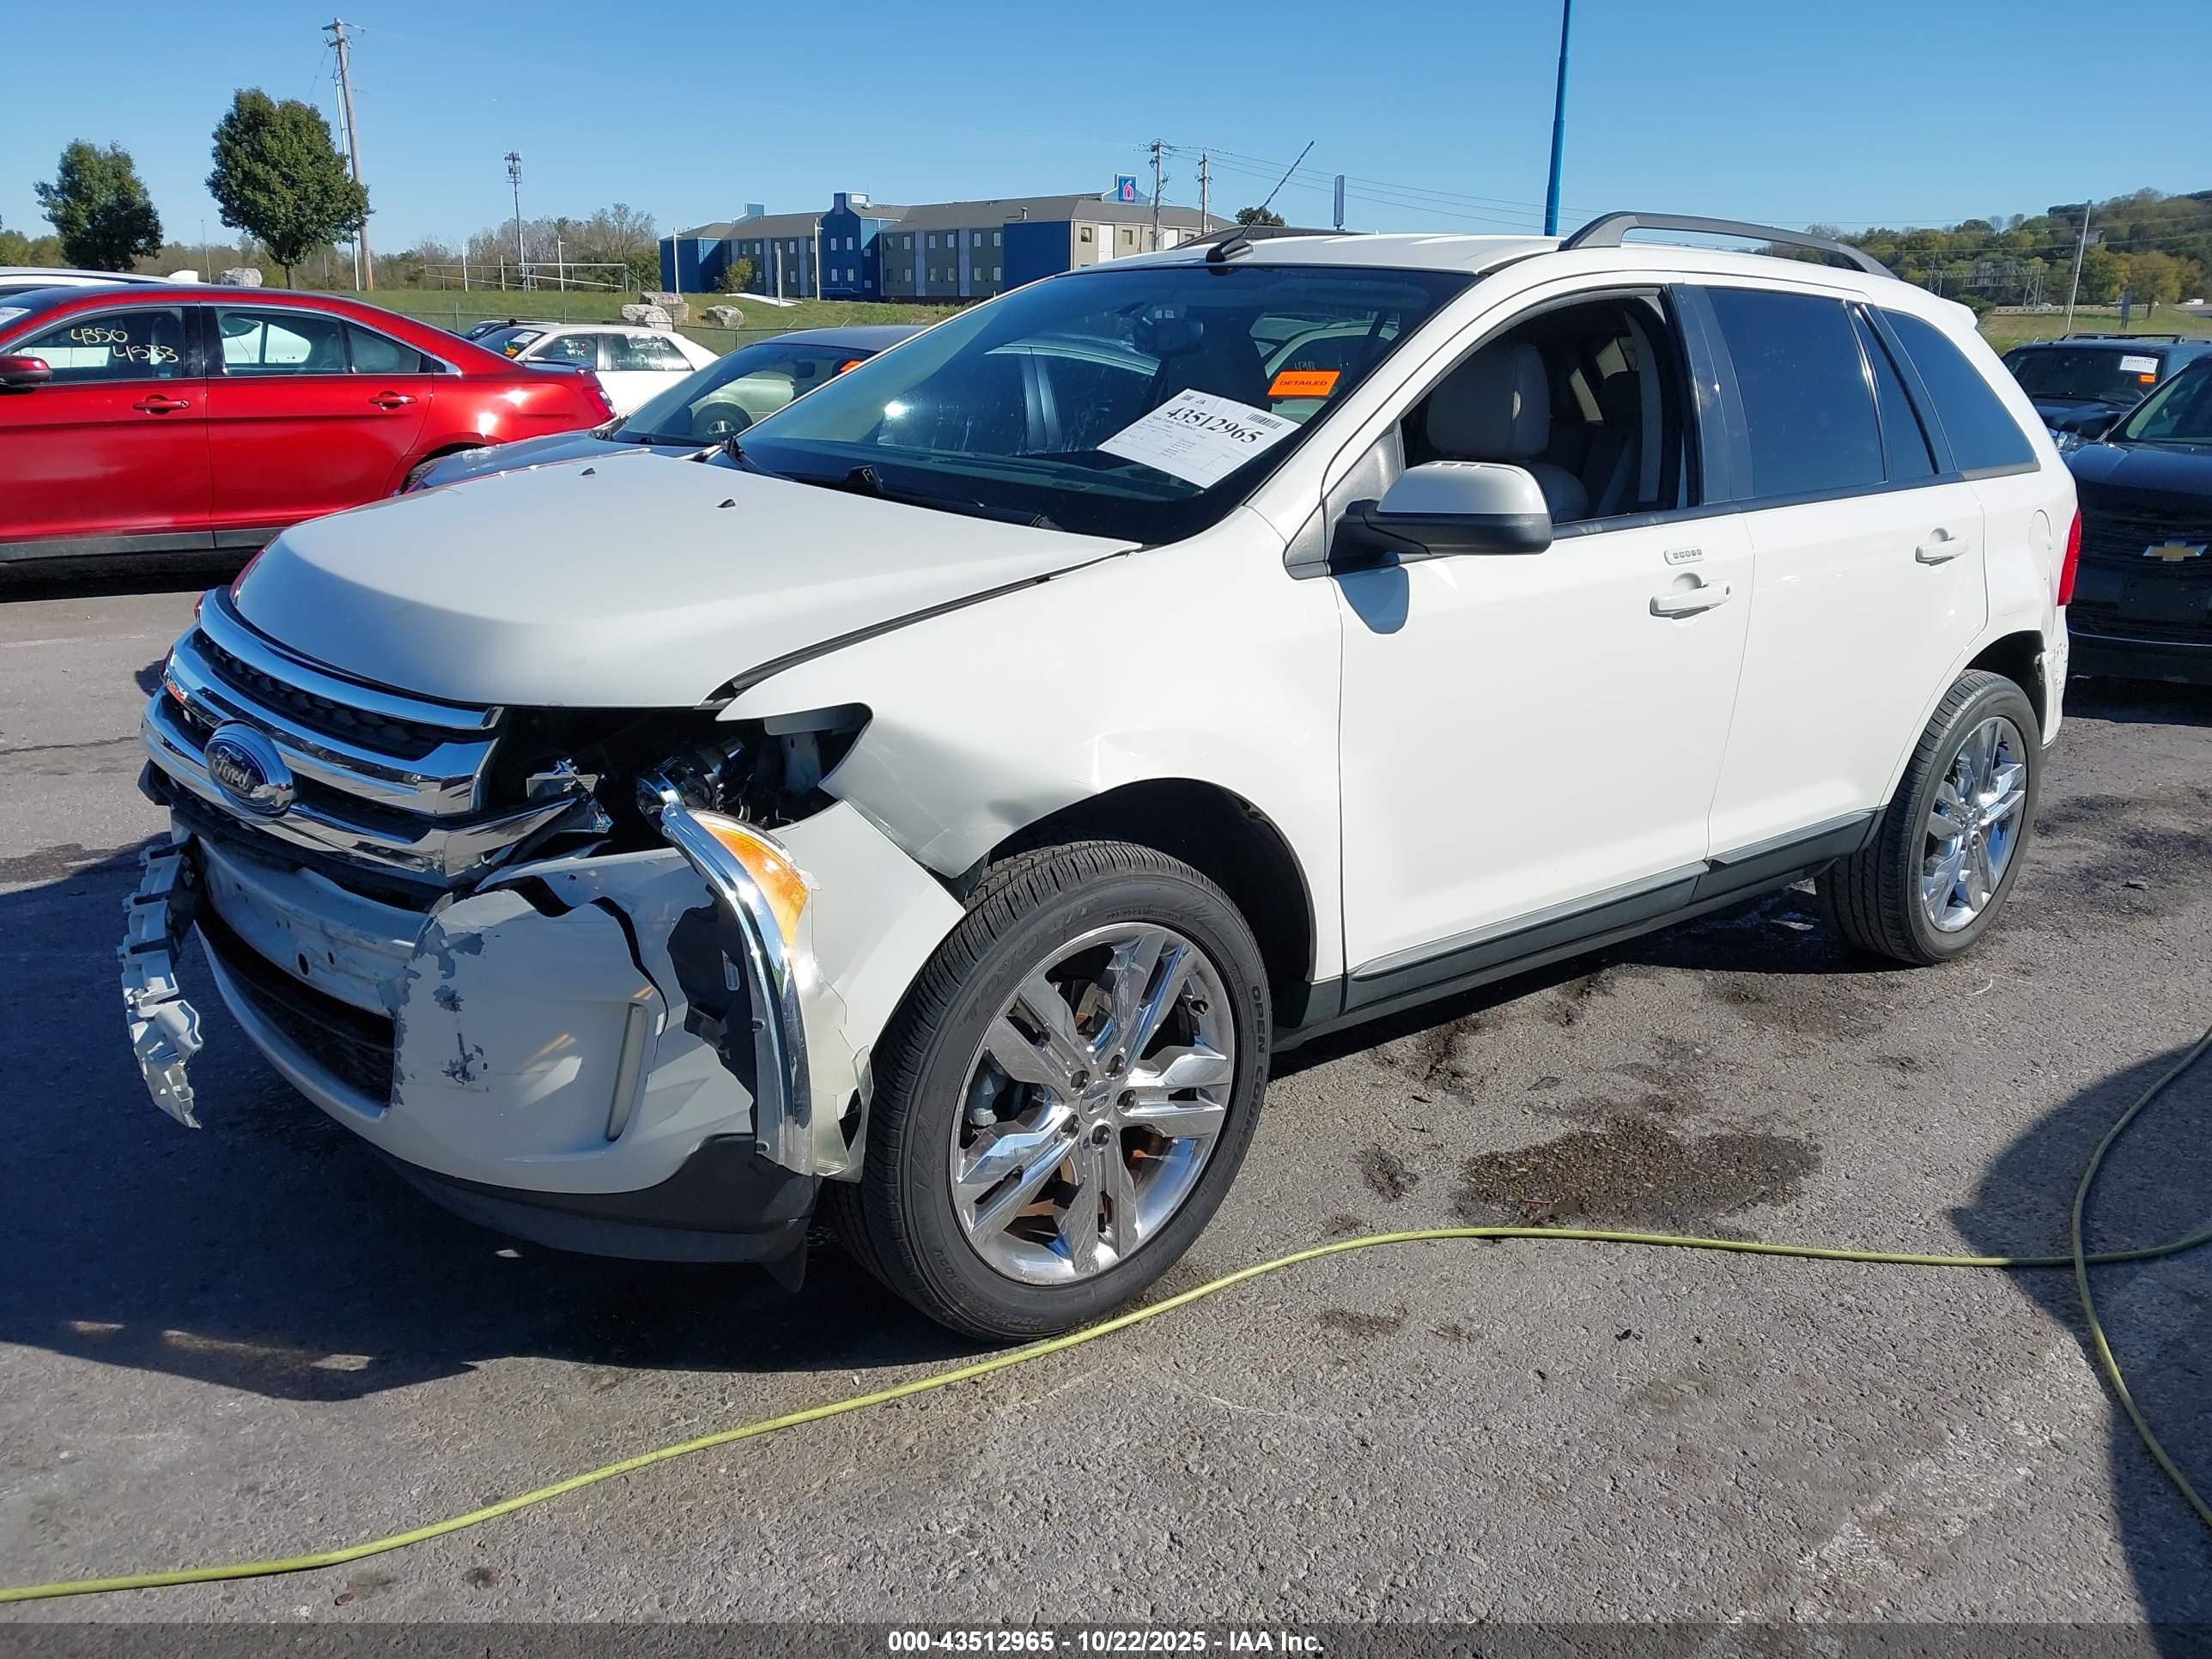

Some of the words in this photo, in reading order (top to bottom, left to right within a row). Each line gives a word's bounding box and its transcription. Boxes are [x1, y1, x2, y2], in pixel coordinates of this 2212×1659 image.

[1123, 179, 1133, 201] 6
[1167, 407, 1265, 443] 43512965
[212, 745, 252, 790] Ford
[1252, 986, 1266, 1053] OPEN
